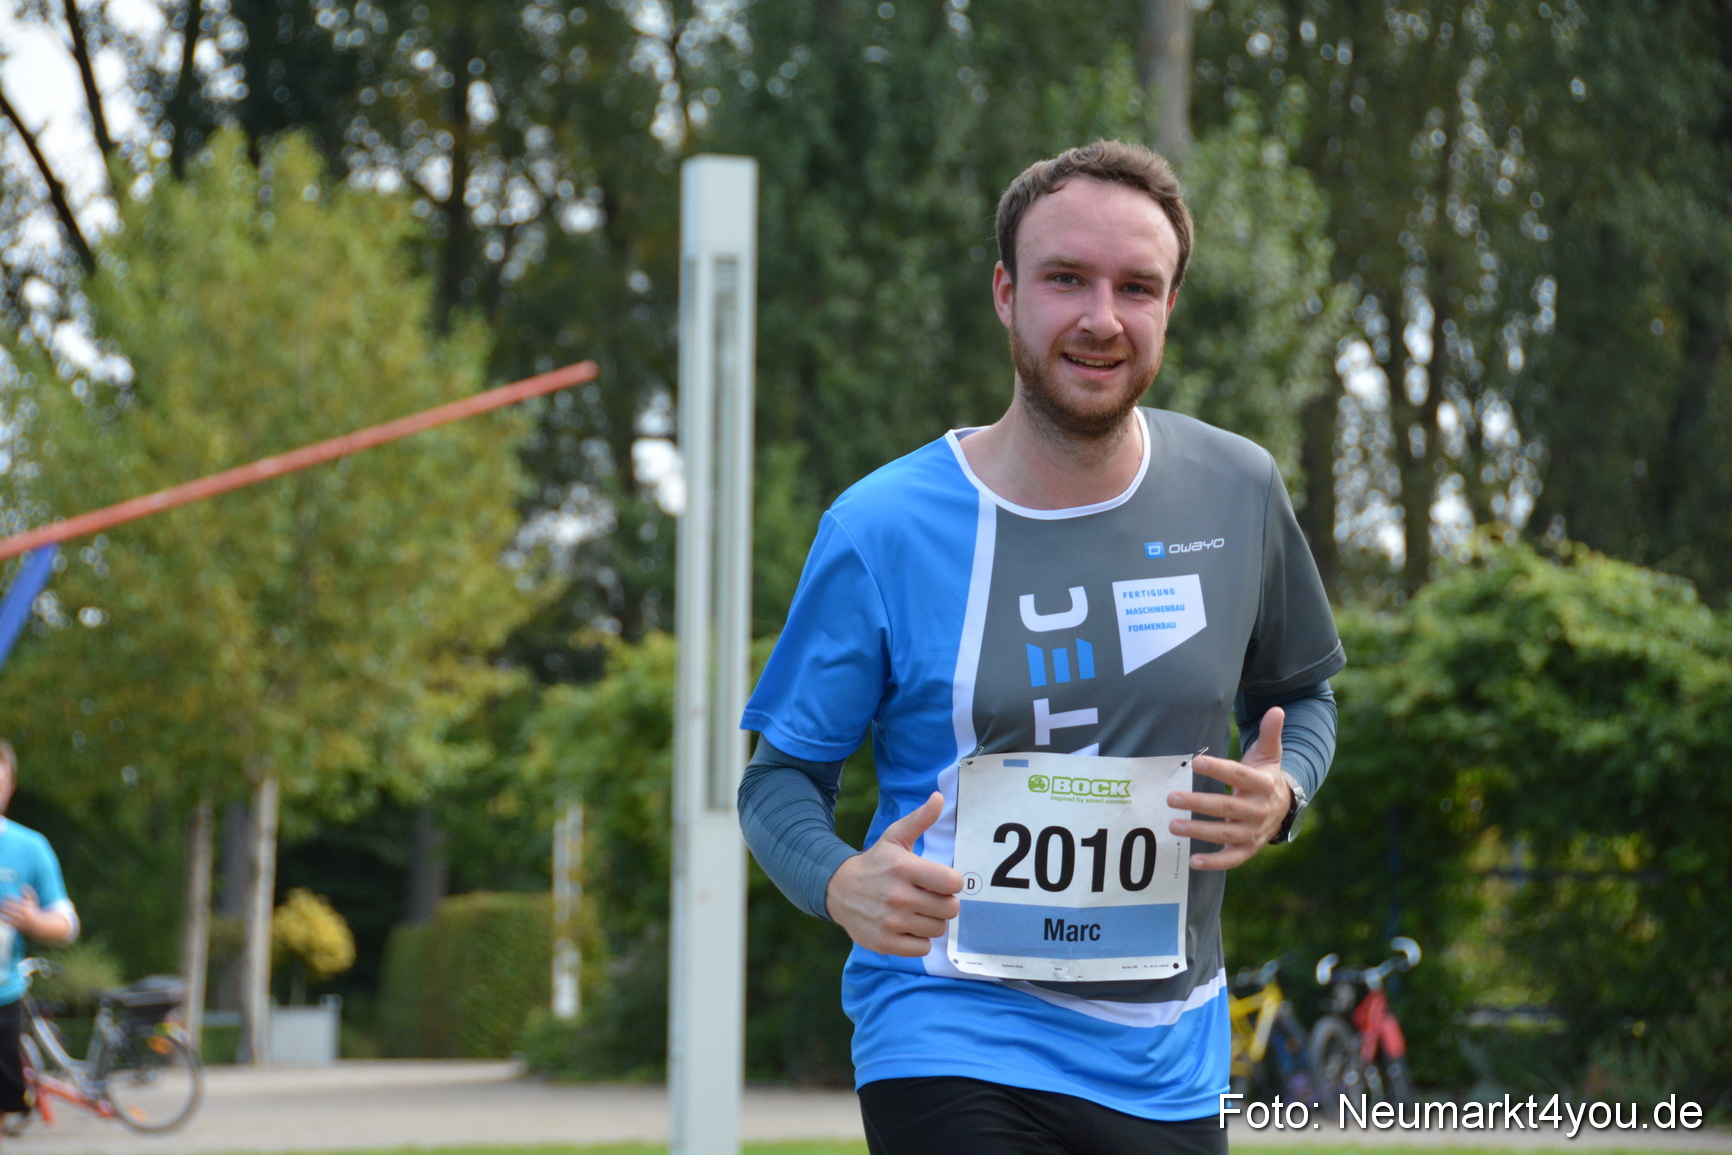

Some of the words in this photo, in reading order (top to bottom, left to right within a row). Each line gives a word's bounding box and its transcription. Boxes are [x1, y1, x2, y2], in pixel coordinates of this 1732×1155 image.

[1123, 588, 1175, 599] FERTIGUNG
[1125, 604, 1185, 615] MASCHINENBAU
[1128, 622, 1176, 632] FORMENBAU
[1019, 585, 1099, 757] TEC
[1051, 776, 1131, 797] BOCK
[1051, 795, 1075, 803] inspired
[1076, 796, 1084, 804] by
[990, 822, 1157, 892] 2010
[967, 878, 975, 890] D
[1043, 918, 1101, 942] Marc
